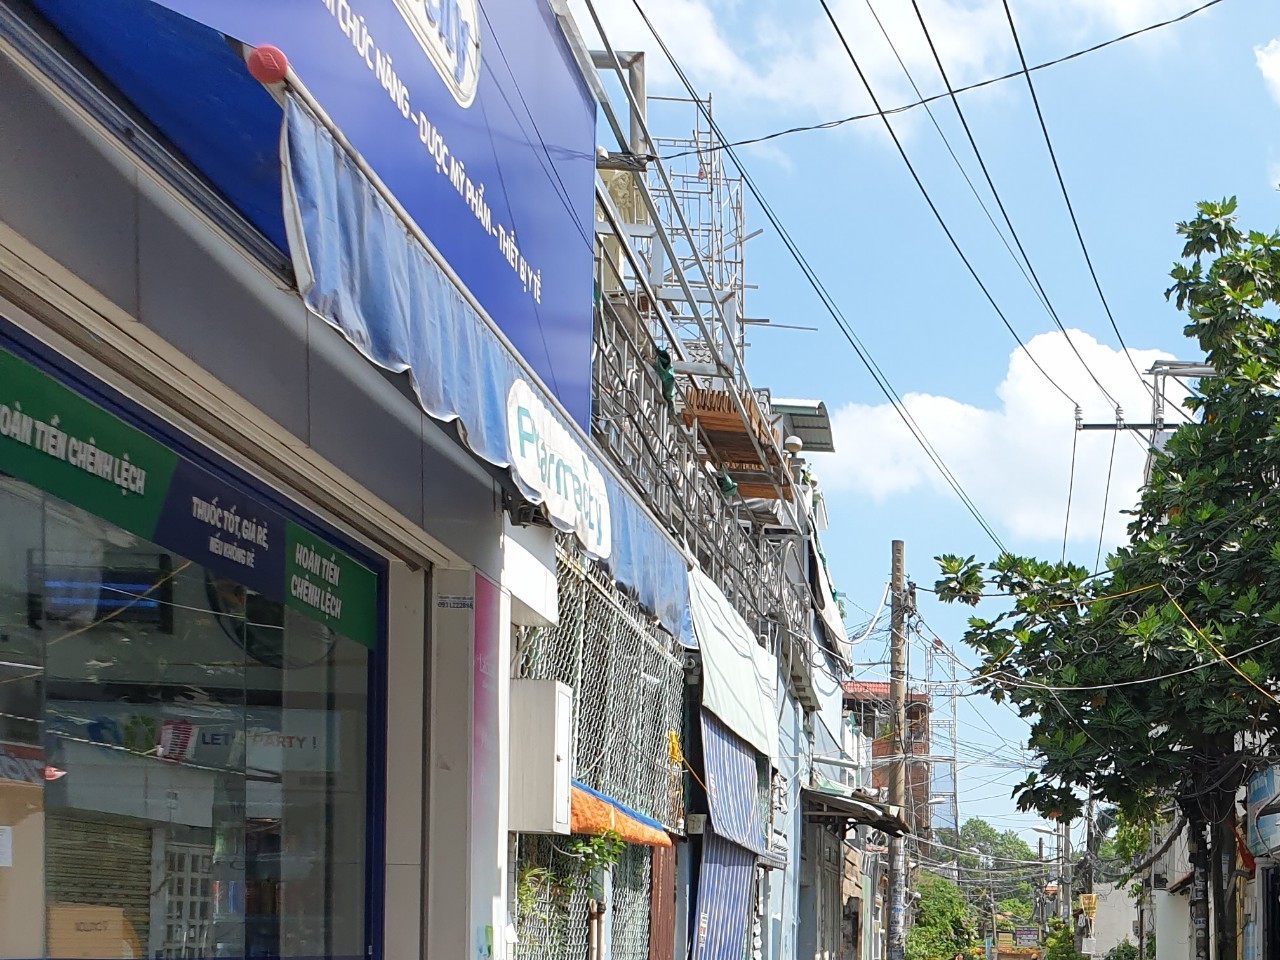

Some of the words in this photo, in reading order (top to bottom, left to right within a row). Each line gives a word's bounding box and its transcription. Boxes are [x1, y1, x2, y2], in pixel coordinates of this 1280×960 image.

[338, 0, 374, 71] CHỨC
[375, 47, 410, 119] NĂNG
[419, 110, 449, 175] DƯỢC
[466, 183, 491, 235] PHẨM
[499, 223, 519, 273] THIẾT
[527, 265, 533, 291] Y
[0, 401, 33, 446] OÀN
[34, 414, 68, 460] TIỀN
[68, 436, 114, 481] CHÊNH
[114, 452, 146, 496] LỆCH
[295, 542, 320, 576] HOÀN
[290, 574, 320, 609] CHÊNH
[320, 587, 342, 620] LỆCH
